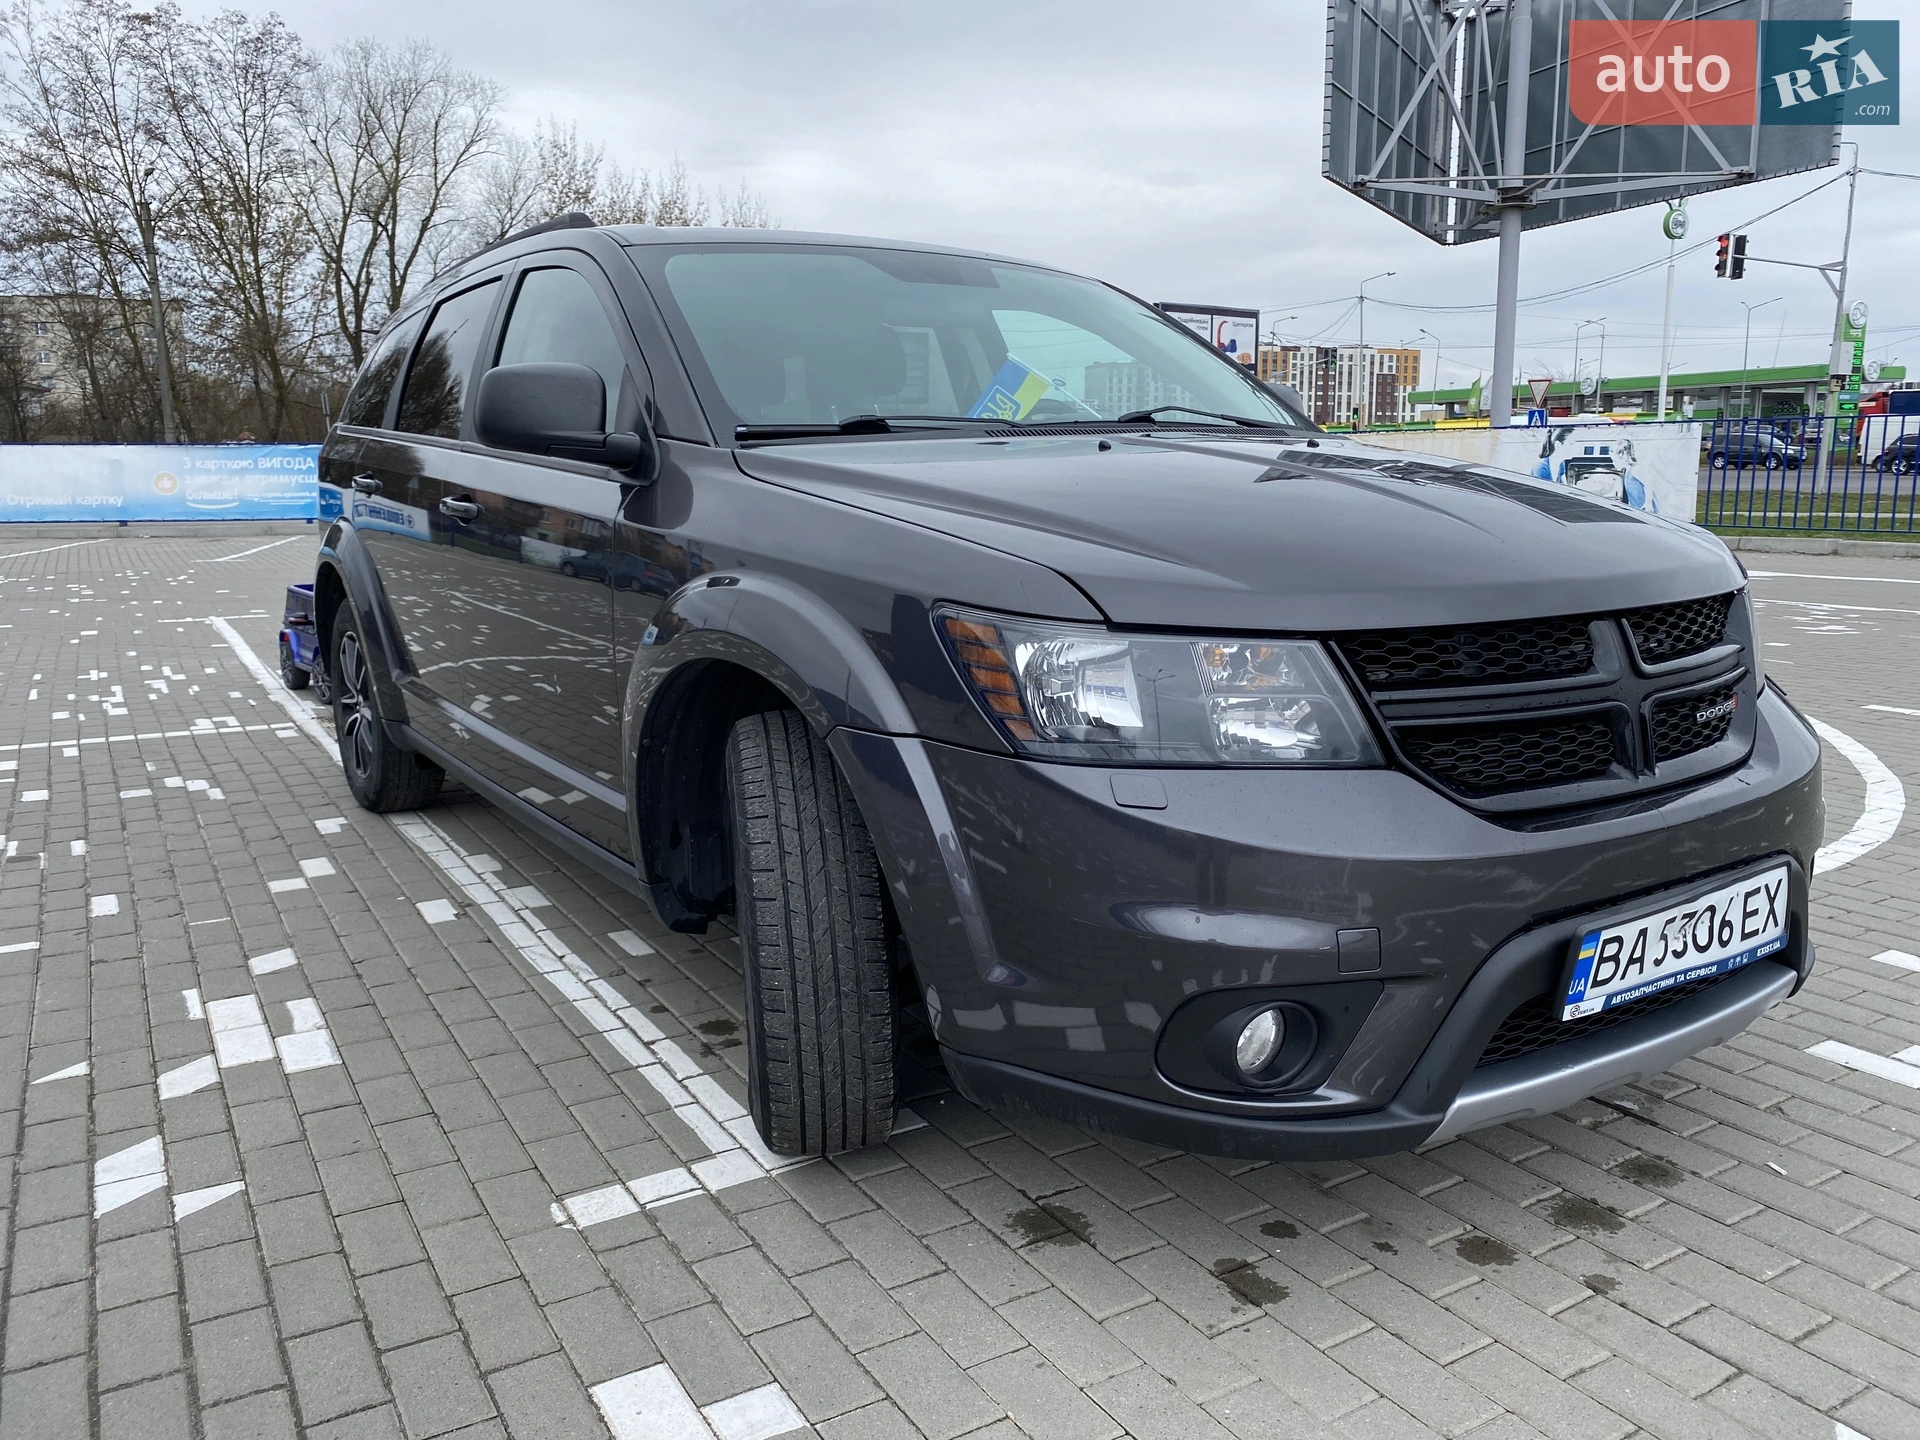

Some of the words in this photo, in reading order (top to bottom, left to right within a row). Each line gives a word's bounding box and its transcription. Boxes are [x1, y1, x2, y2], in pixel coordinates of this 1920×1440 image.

[1772, 404, 1800, 417] goods
[195, 459, 254, 472] карткою
[258, 456, 315, 471] ВИГОДА
[6, 494, 73, 509] Отримай
[76, 495, 124, 508] картку
[1696, 699, 1737, 722] DODGE
[1757, 941, 1780, 956] EXIST.UA
[1568, 978, 1585, 995] UA
[1611, 976, 1675, 1005] АВТОЗАПЧАСТИНИ
[1676, 973, 1685, 984] ТА
[1686, 965, 1717, 980] СЕРВІСИ
